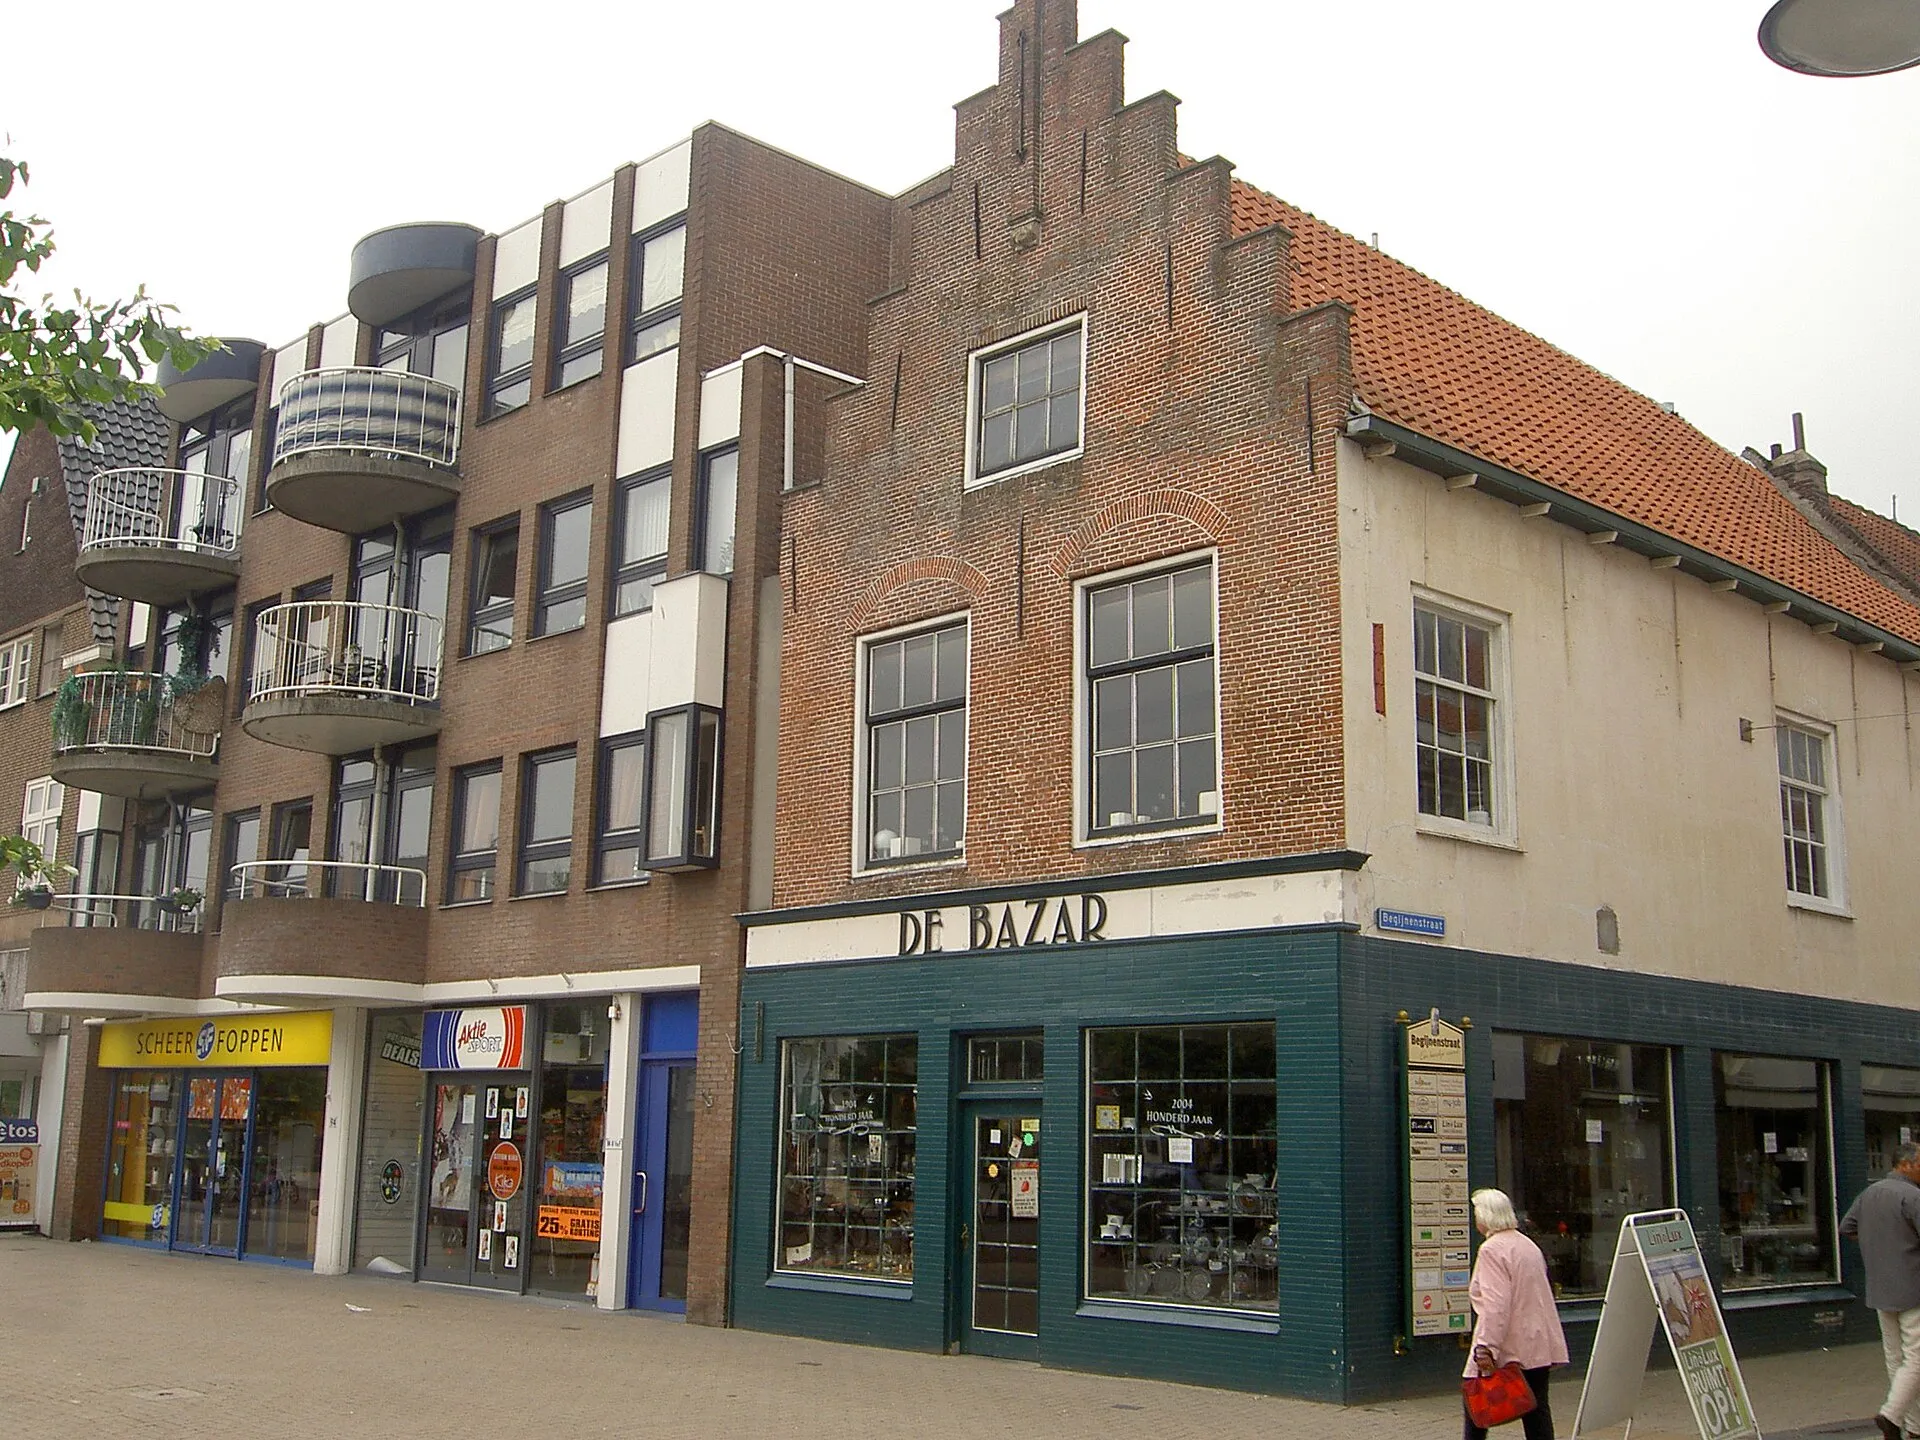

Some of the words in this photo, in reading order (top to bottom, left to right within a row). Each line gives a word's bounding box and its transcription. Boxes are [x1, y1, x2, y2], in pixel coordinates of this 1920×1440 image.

[899, 909, 944, 956] DE
[968, 894, 1107, 951] BAZAR
[1382, 912, 1443, 931] Begijnenstraat
[136, 1031, 193, 1055] SCHEER
[216, 1027, 284, 1053] FOPPEN
[458, 1019, 487, 1049] Aktie
[1411, 1034, 1461, 1049] Begijnenstraat
[467, 1036, 502, 1053] SPORT
[1171, 1098, 1194, 1110] 2004
[824, 1112, 857, 1123] HONDERD
[857, 1110, 874, 1121] JAAR
[1146, 1110, 1190, 1124] HONDERD
[1190, 1114, 1213, 1125] JAAR
[570, 1218, 600, 1229] GRATIS
[569, 1228, 600, 1238] KORTING
[1689, 1364, 1727, 1395] RUIMT
[1700, 1386, 1742, 1436] OP!
